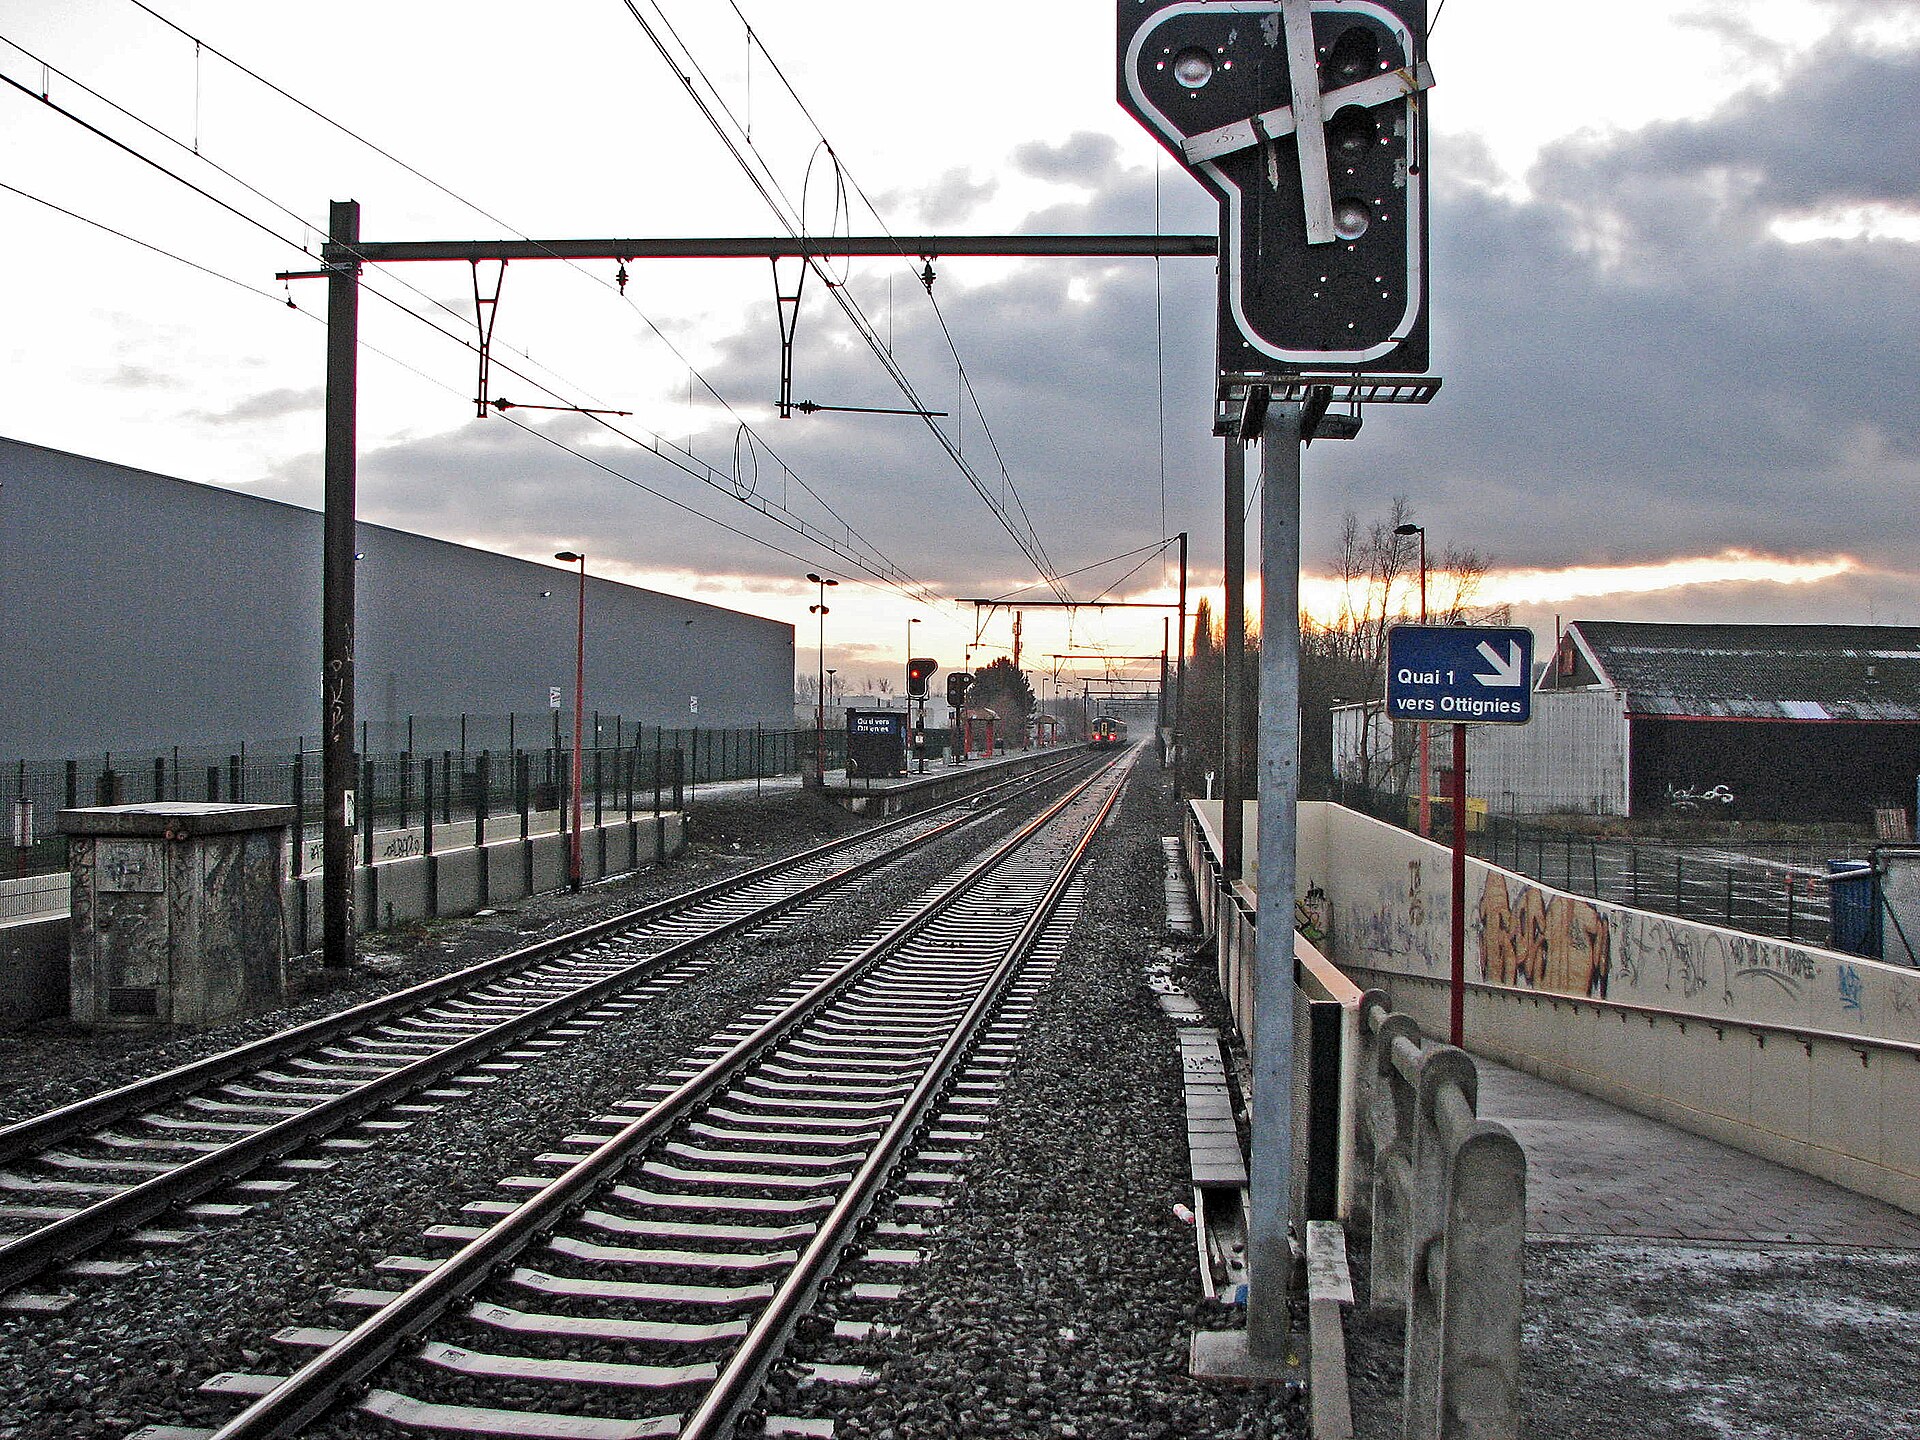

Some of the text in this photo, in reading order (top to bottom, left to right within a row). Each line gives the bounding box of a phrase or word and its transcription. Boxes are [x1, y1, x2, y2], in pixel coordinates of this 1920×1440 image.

[1397, 669, 1455, 685] Quai 1
[1396, 696, 1521, 716] vers Ottignies
